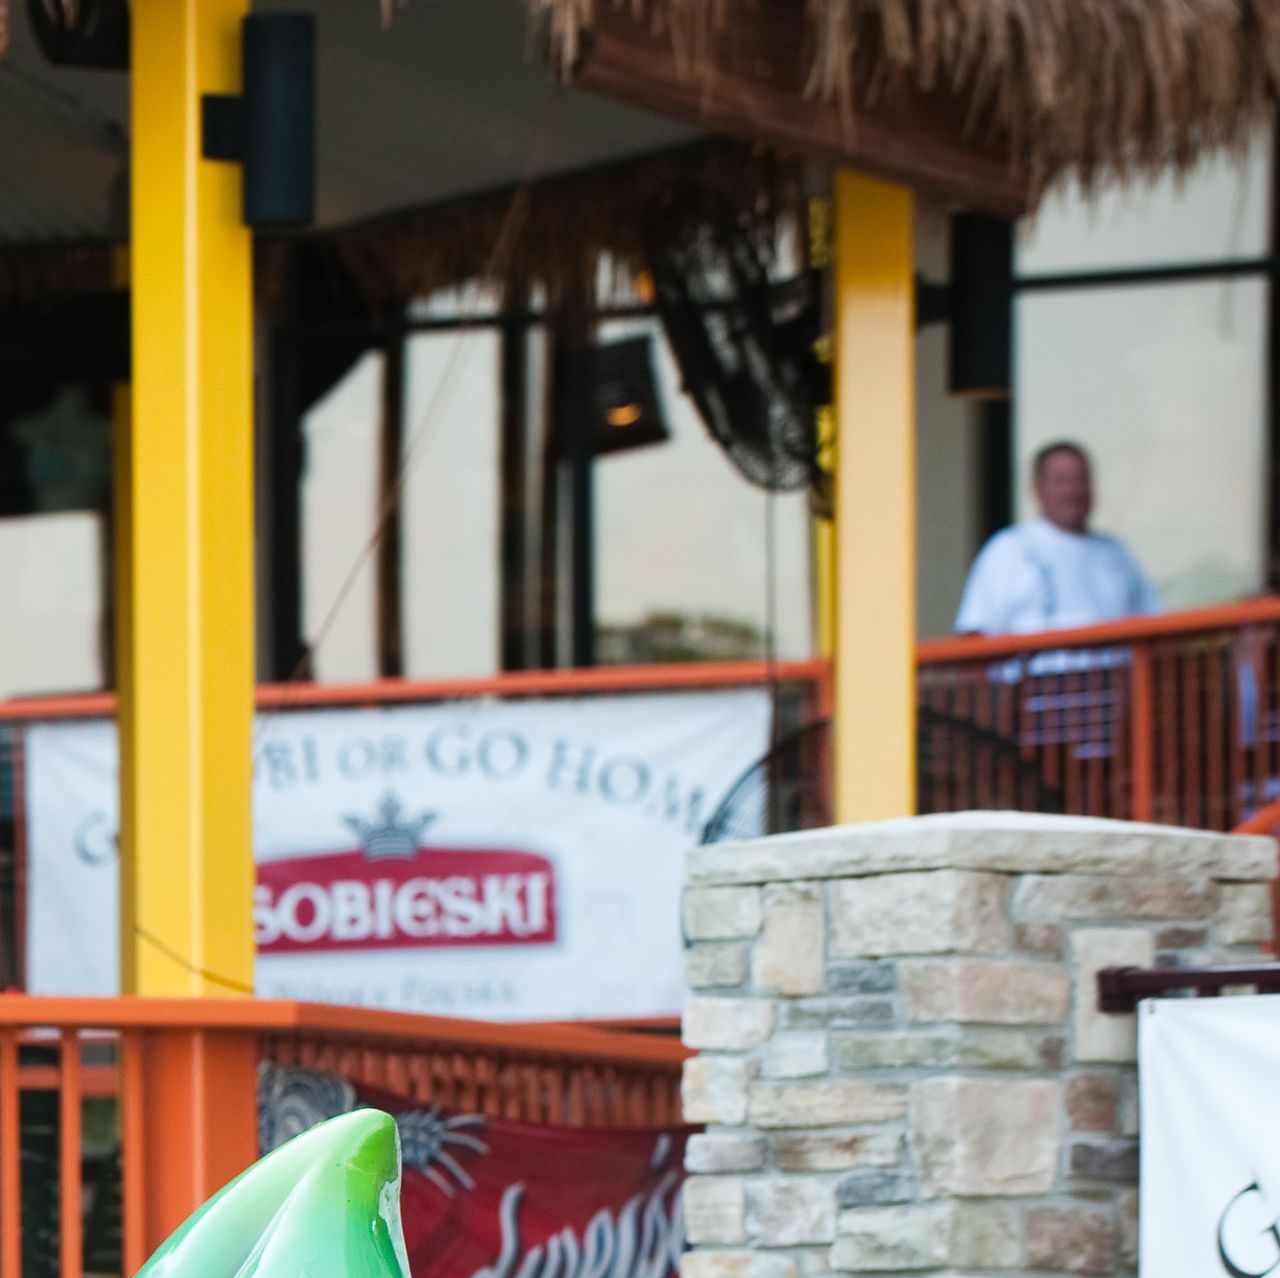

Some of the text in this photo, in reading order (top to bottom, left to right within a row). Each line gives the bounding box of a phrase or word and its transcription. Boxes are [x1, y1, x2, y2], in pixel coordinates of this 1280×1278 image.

[73, 808, 117, 868] G
[255, 732, 321, 792] BI
[425, 722, 530, 782] GO
[546, 736, 705, 835] HOM
[254, 870, 549, 945] SOBIESKI
